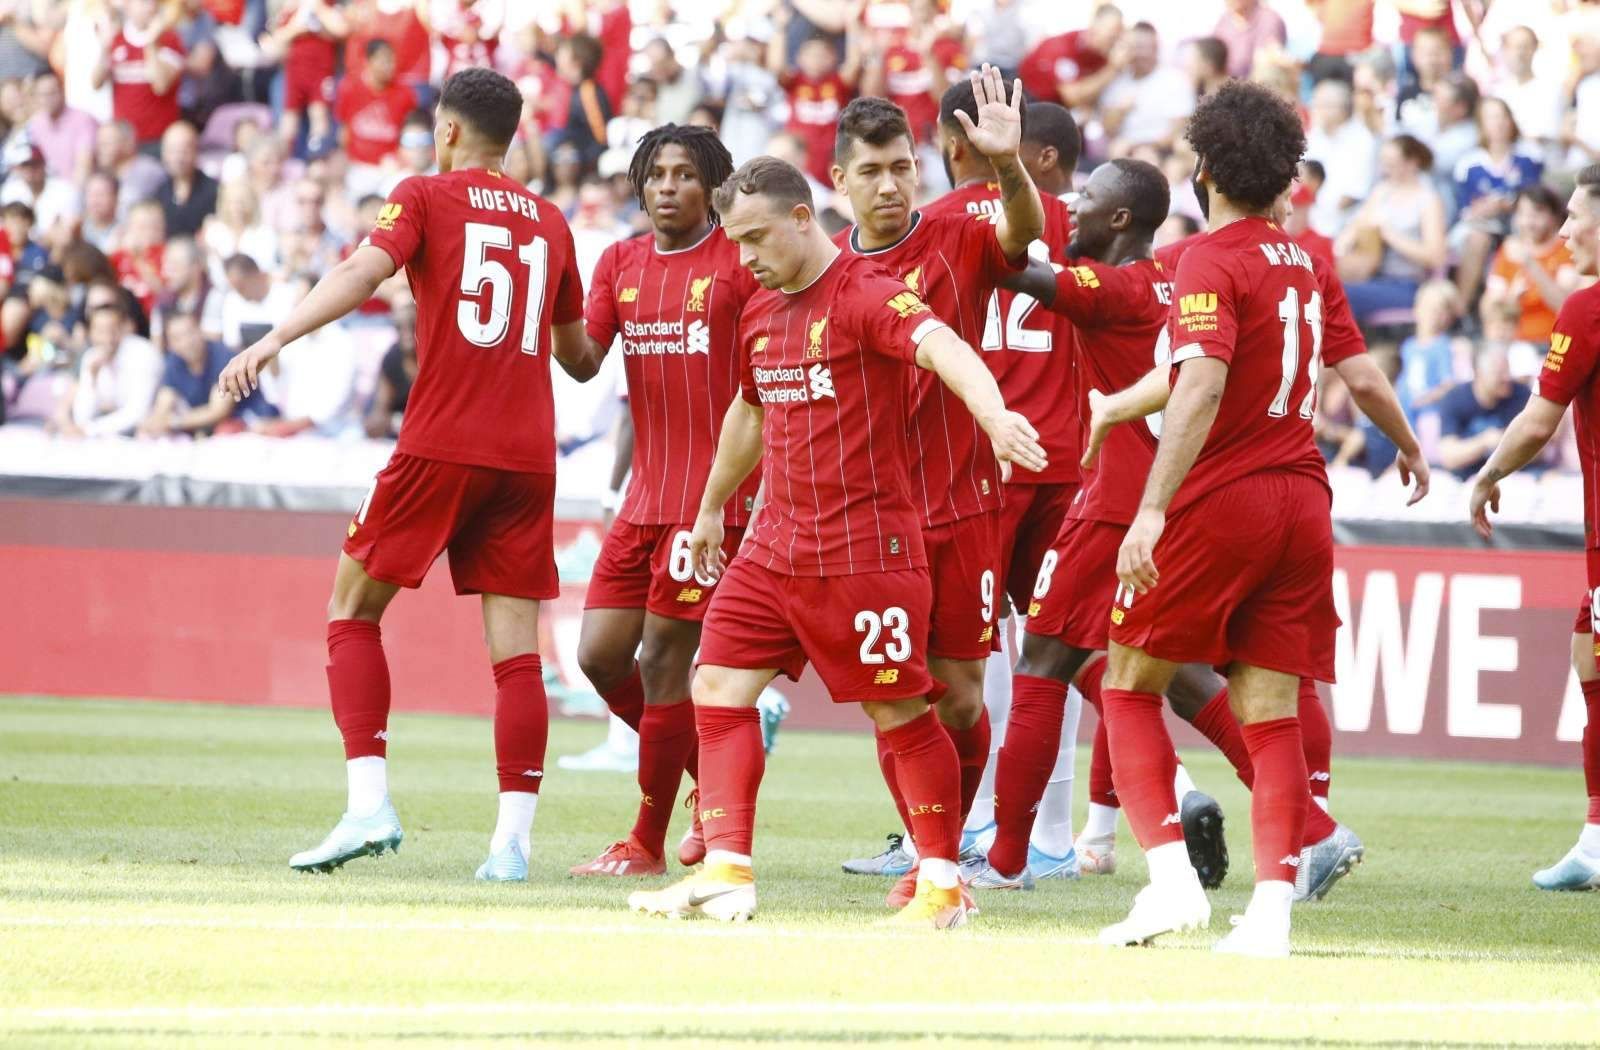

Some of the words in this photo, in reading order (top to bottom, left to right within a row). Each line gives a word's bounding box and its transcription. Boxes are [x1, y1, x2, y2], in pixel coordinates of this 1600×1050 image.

[468, 186, 540, 222] HOEVER
[457, 222, 547, 356] 51
[1179, 293, 1217, 315] WU
[624, 320, 683, 336] Standard
[1178, 315, 1217, 325] Western
[1188, 322, 1217, 332] Union
[623, 339, 685, 355] Chartered
[1268, 287, 1321, 419] 11
[980, 569, 994, 623] 9
[1033, 549, 1058, 600] 8
[854, 606, 911, 665] 23
[1331, 568, 1522, 740] WE
